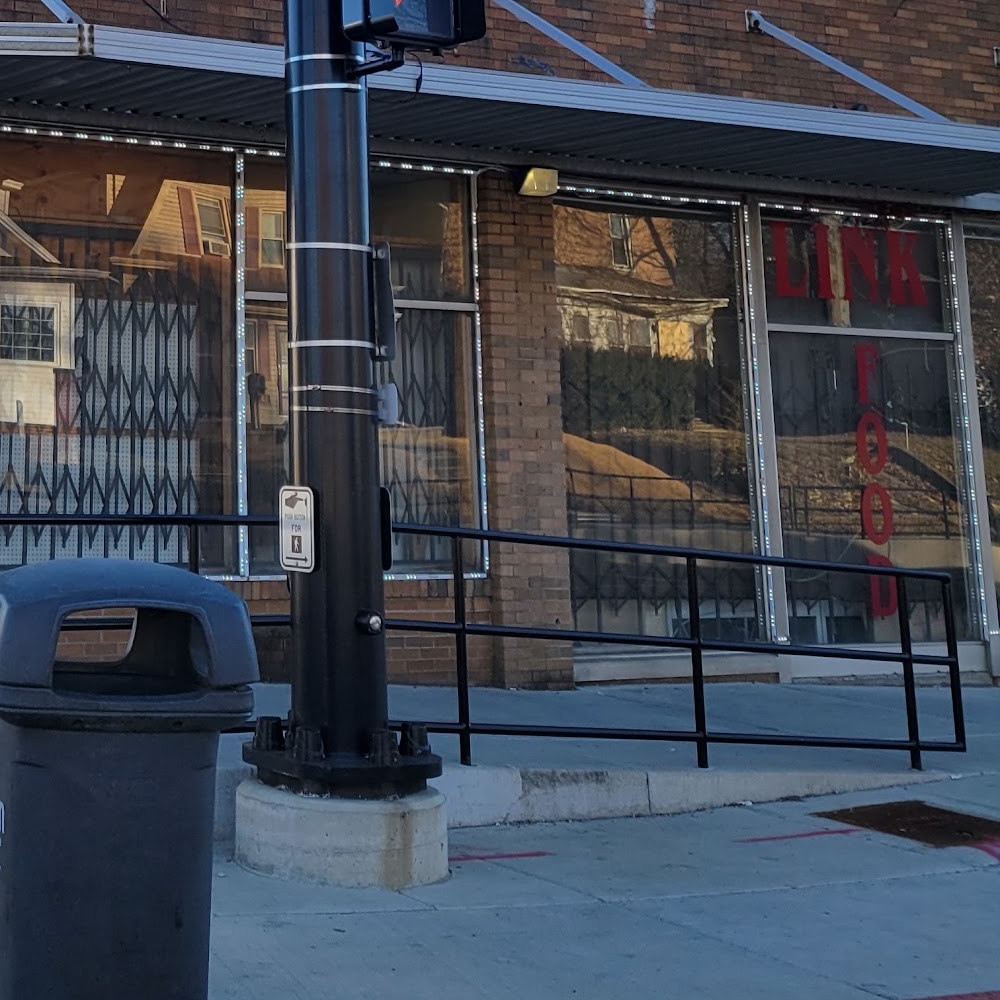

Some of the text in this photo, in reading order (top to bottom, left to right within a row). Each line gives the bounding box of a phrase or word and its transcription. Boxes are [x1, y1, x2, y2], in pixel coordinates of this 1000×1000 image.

[770, 220, 929, 306] LINK
[854, 343, 898, 618] FOOD
[292, 524, 301, 533] FOR
